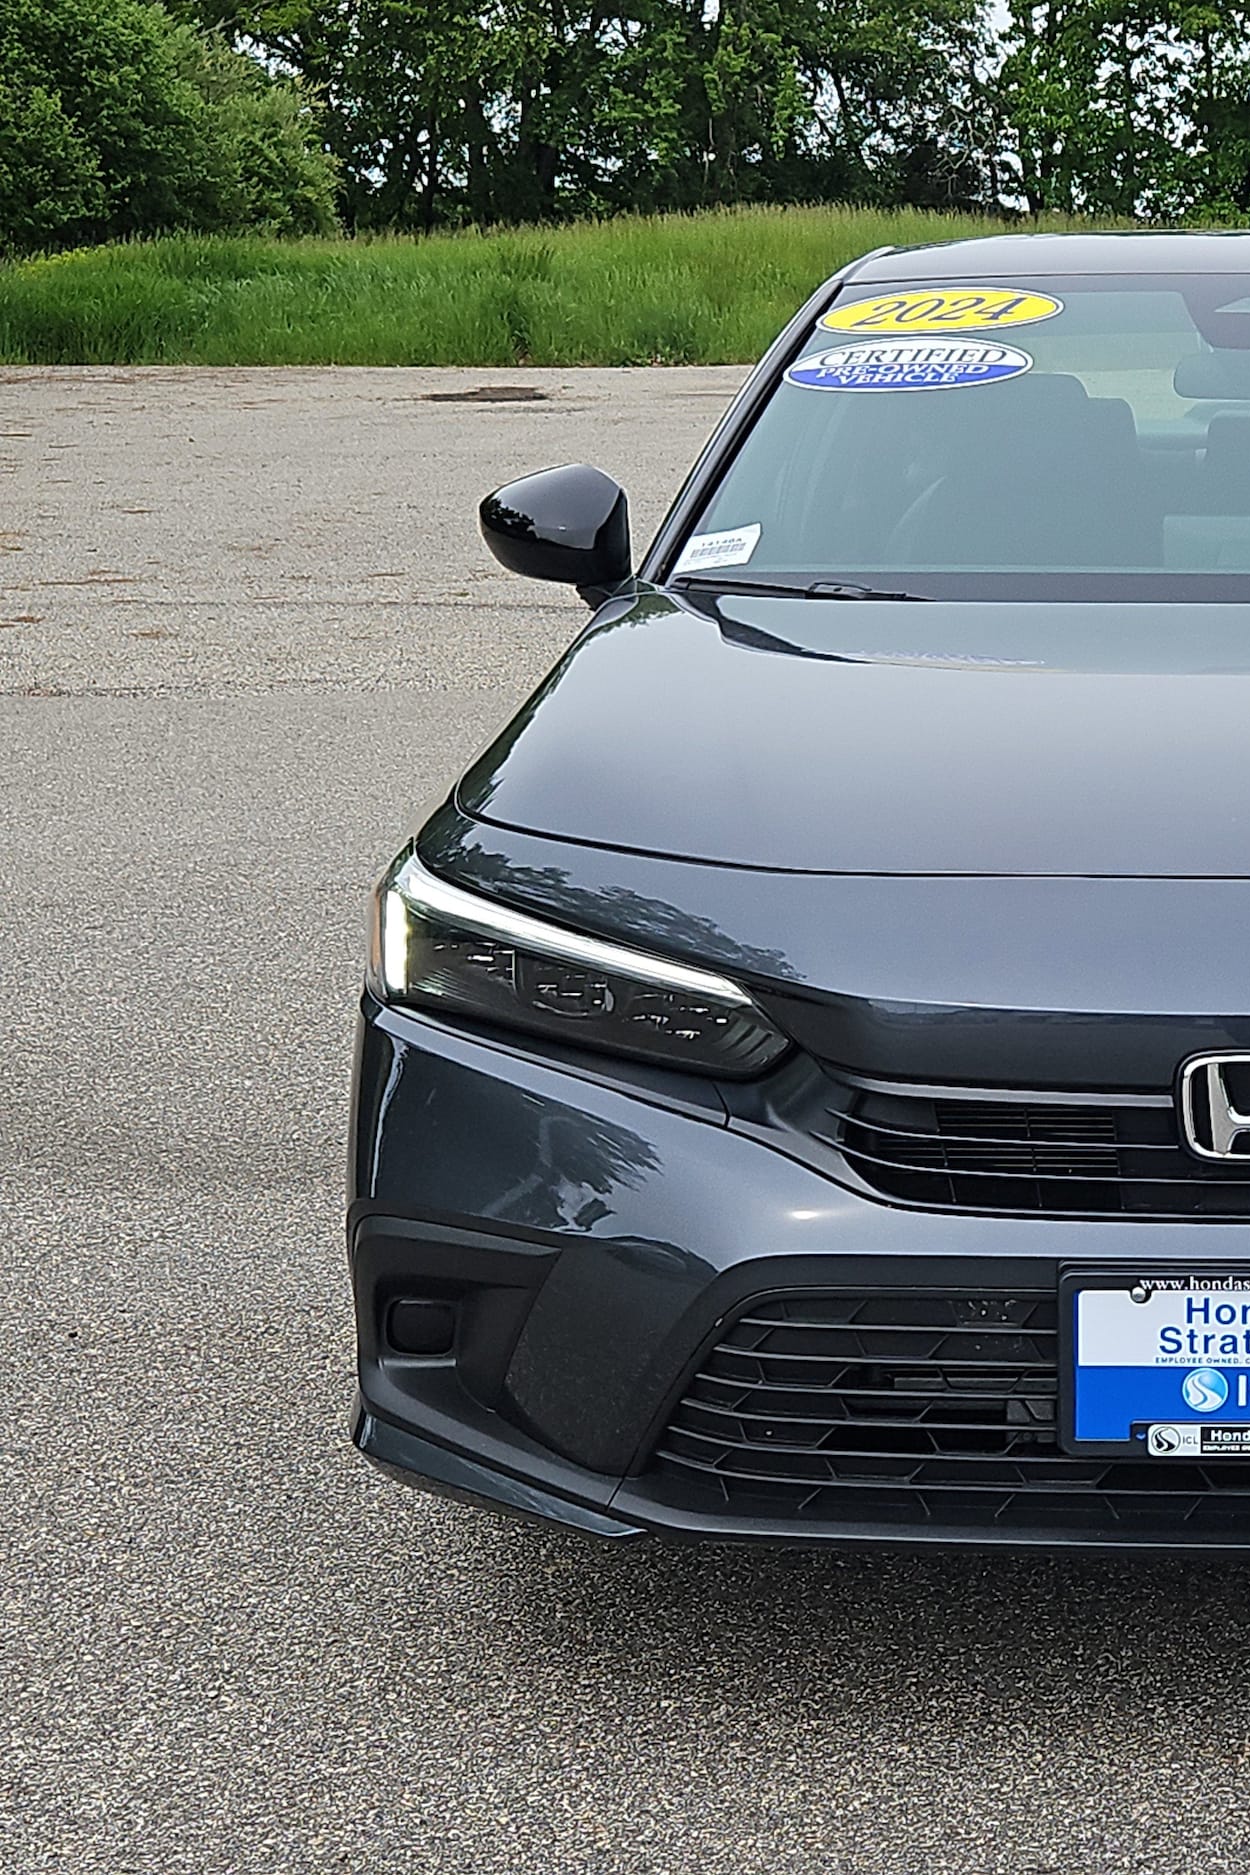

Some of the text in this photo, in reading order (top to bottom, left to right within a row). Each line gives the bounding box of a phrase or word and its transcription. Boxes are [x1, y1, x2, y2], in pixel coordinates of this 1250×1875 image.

[849, 296, 1028, 328] 2024
[820, 347, 1008, 367] CERTIFIED
[815, 363, 990, 379] PRE-OWNED
[838, 371, 959, 386] VEHICLE
[1182, 1435, 1199, 1445] ICL
